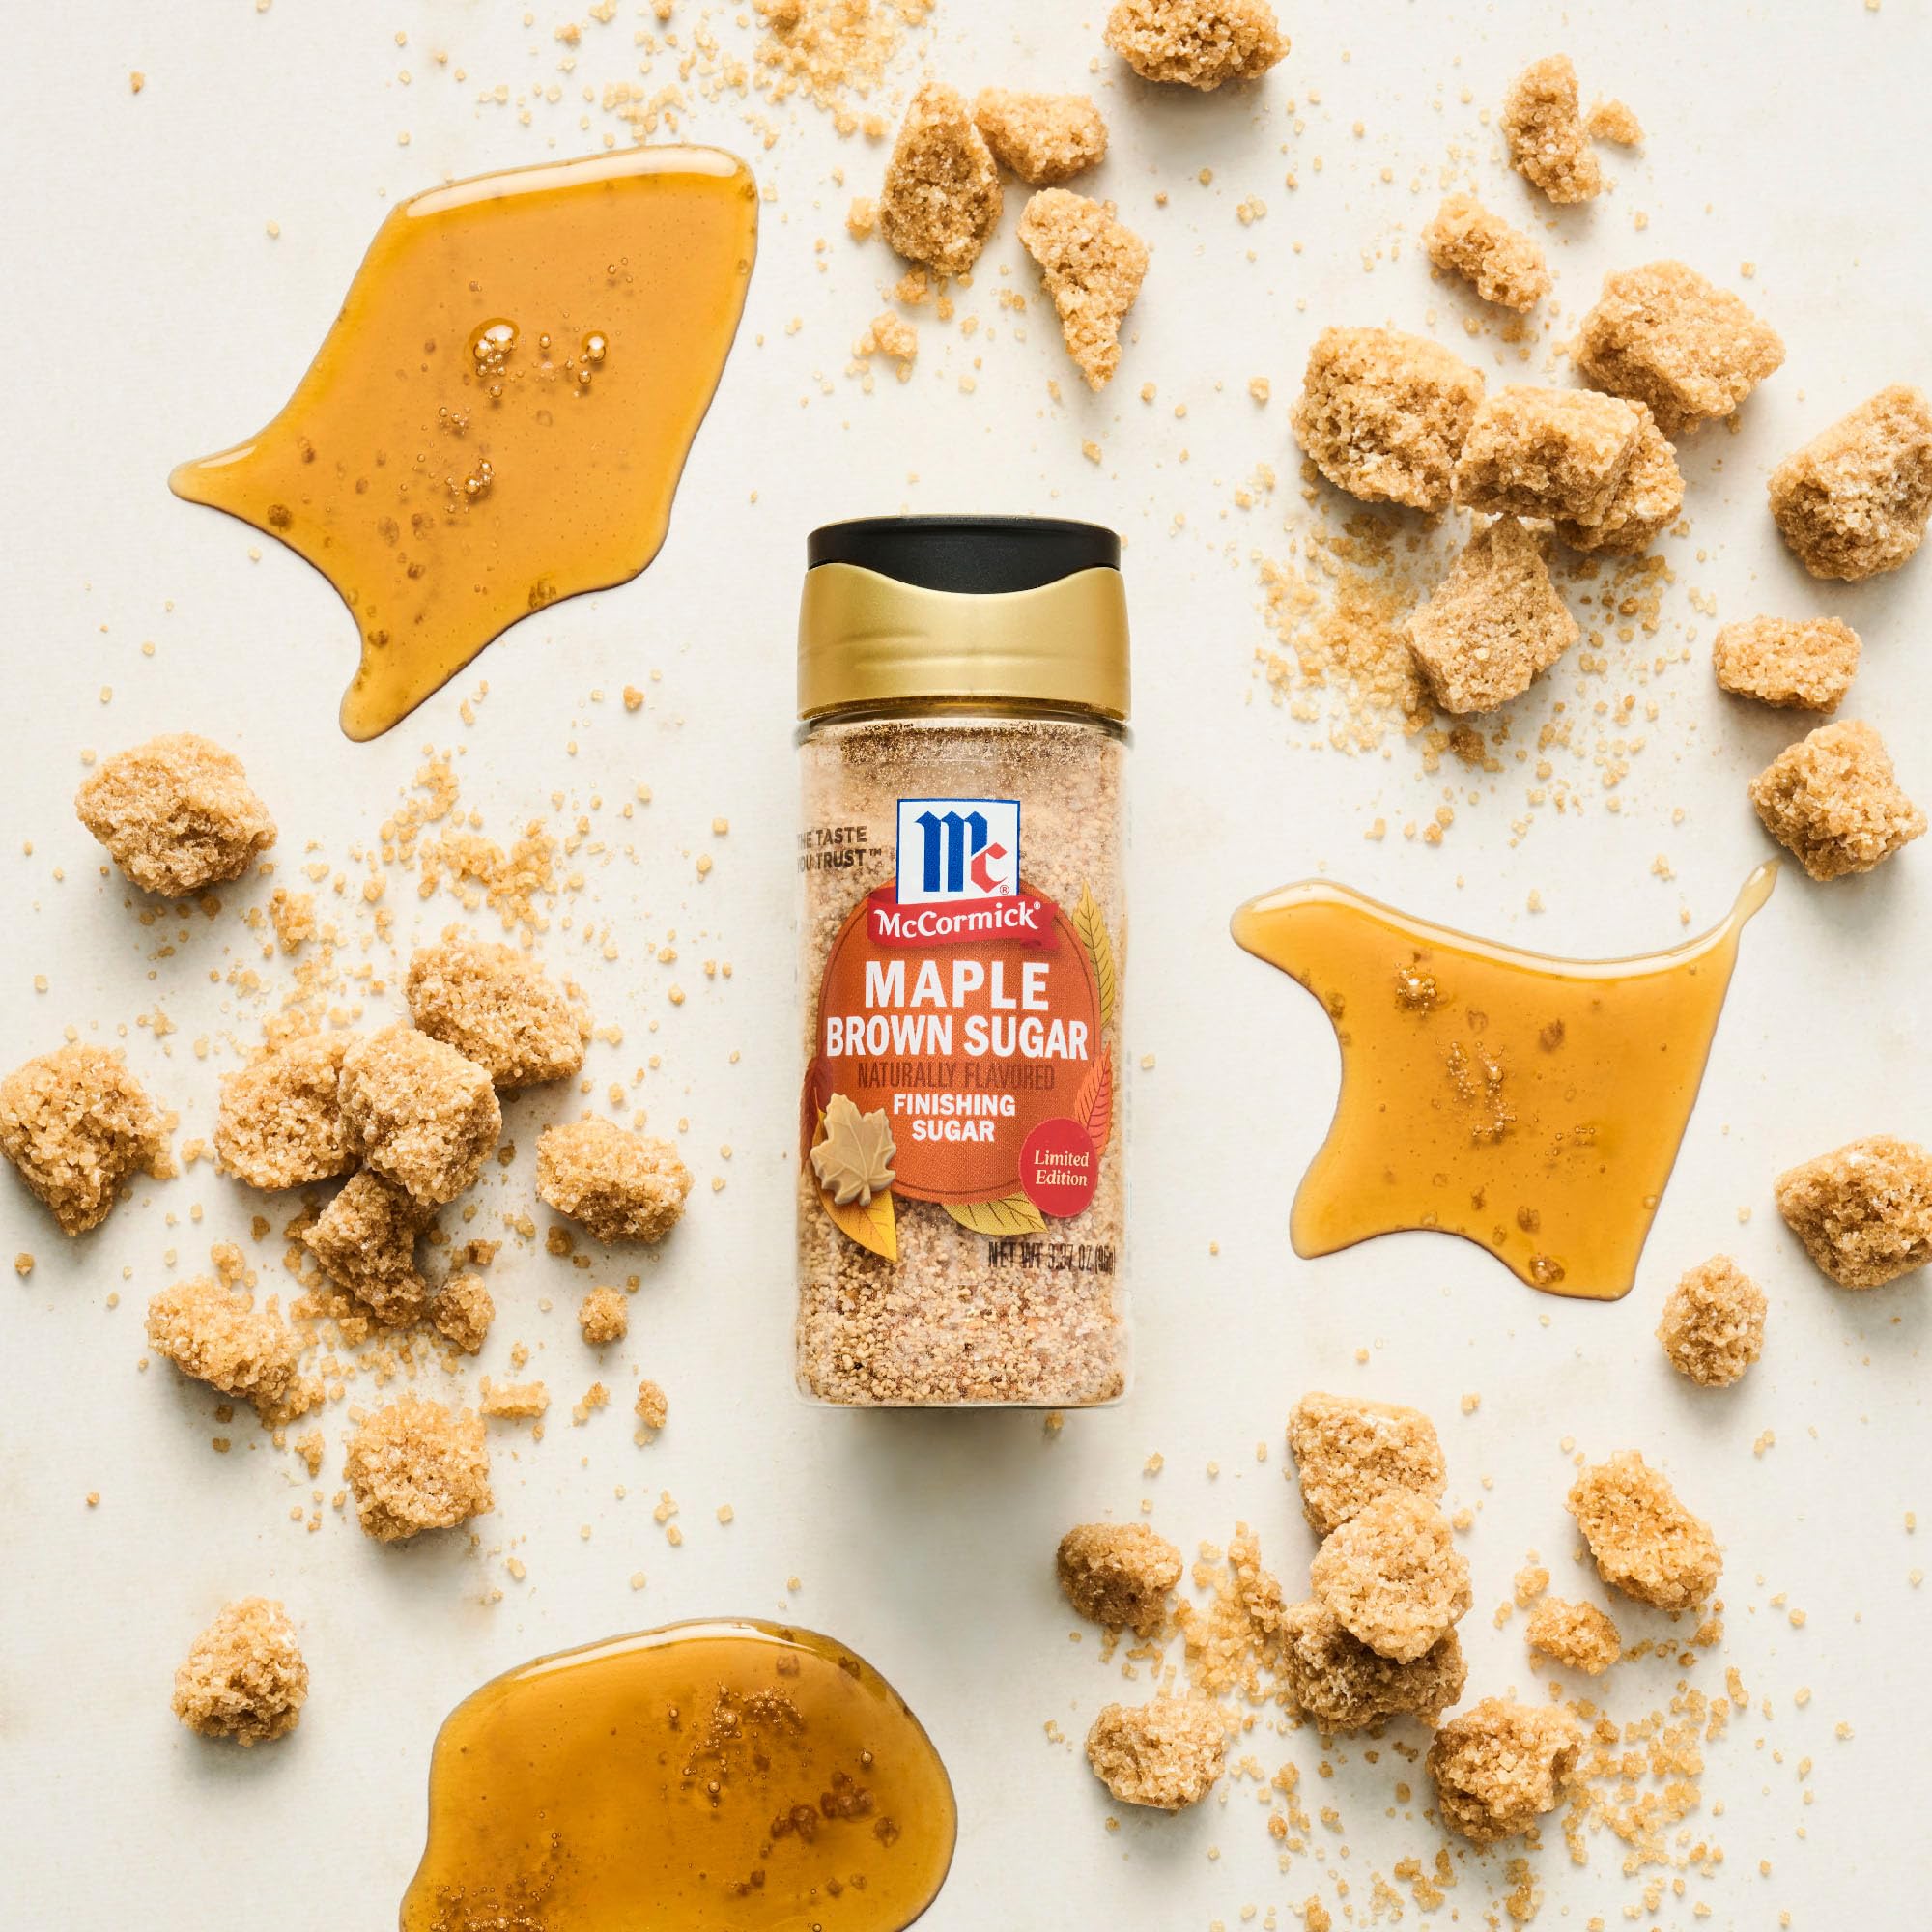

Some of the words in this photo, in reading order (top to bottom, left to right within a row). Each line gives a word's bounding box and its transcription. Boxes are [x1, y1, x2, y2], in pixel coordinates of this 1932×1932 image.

[816, 826, 867, 846] TASTE
[865, 960, 1050, 1011] MAPLE
[826, 1015, 952, 1057] BROWN
[963, 1016, 1089, 1061] SUGAR
[858, 1062, 955, 1089] NATURALLY
[964, 1065, 1055, 1091] FLAVORED
[893, 1094, 1016, 1117] FINISHING
[911, 1119, 995, 1142] SUGAR
[1034, 1149, 1090, 1167] Limited
[1035, 1169, 1088, 1186] Edition
[988, 1241, 1016, 1268] NET
[1021, 1242, 1042, 1269] WT
[1078, 1243, 1092, 1271] OZ
